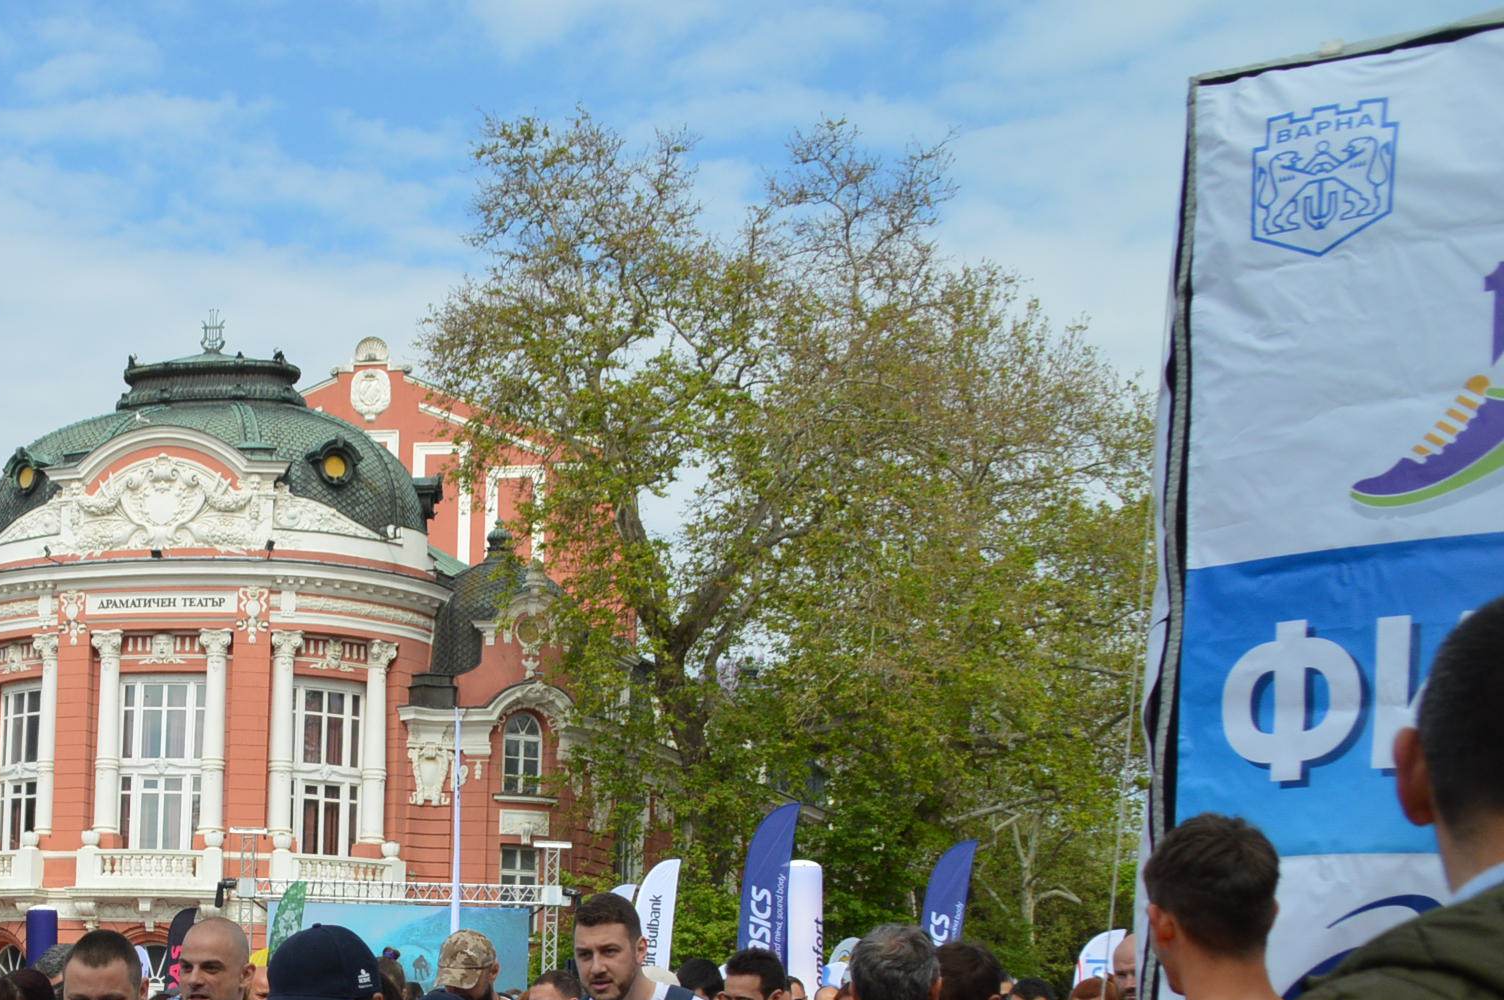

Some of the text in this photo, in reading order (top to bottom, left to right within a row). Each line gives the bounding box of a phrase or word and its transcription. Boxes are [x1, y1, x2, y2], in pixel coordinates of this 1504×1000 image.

[1276, 114, 1374, 144] ВАРНА
[98, 597, 225, 609] ДРАМАТИЧЕН ТЕАТЪР
[646, 894, 663, 948] Bulbank
